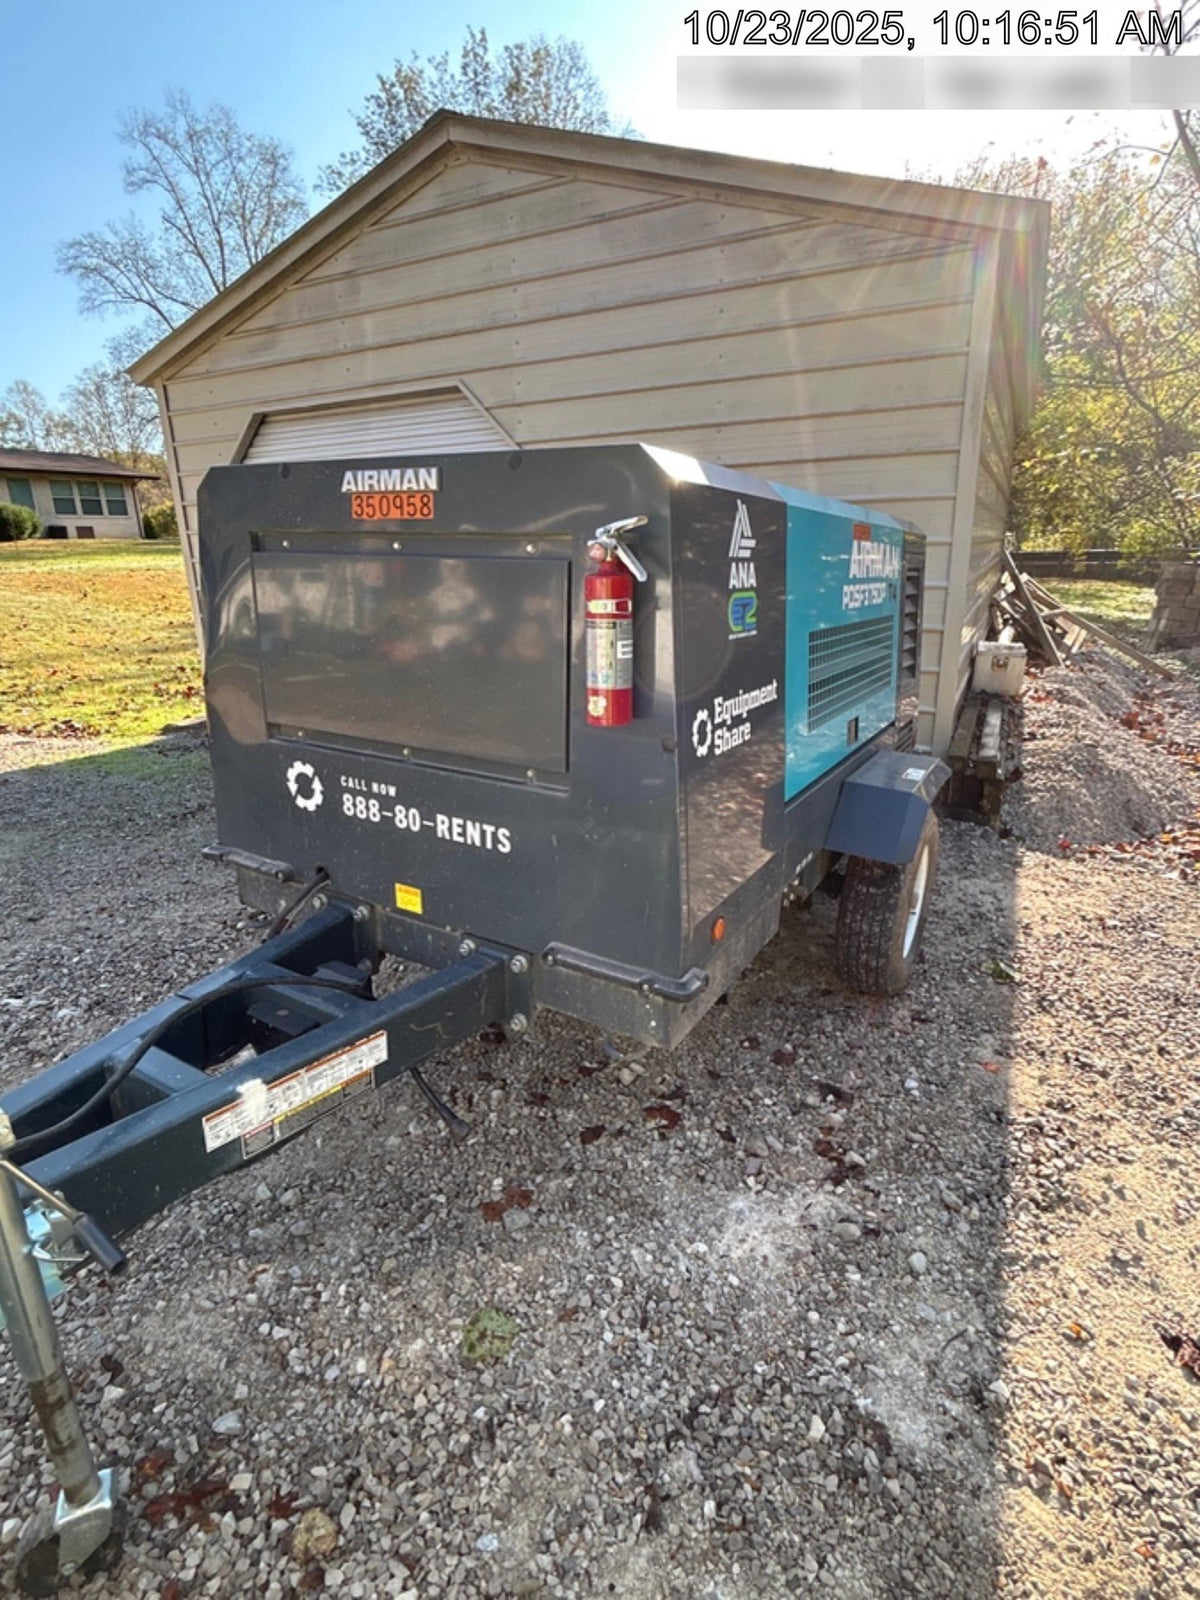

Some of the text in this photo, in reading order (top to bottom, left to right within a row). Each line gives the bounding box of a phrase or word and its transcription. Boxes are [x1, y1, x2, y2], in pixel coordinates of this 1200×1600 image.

[341, 467, 438, 492] AIRMAN
[354, 494, 432, 518] 350958
[849, 541, 902, 579] AIRMAN
[729, 562, 757, 589] ANA
[714, 679, 777, 724] Equipment
[714, 722, 751, 756] Share
[340, 775, 397, 797] CALL NOW
[342, 793, 512, 853] 888-80-RENTS
